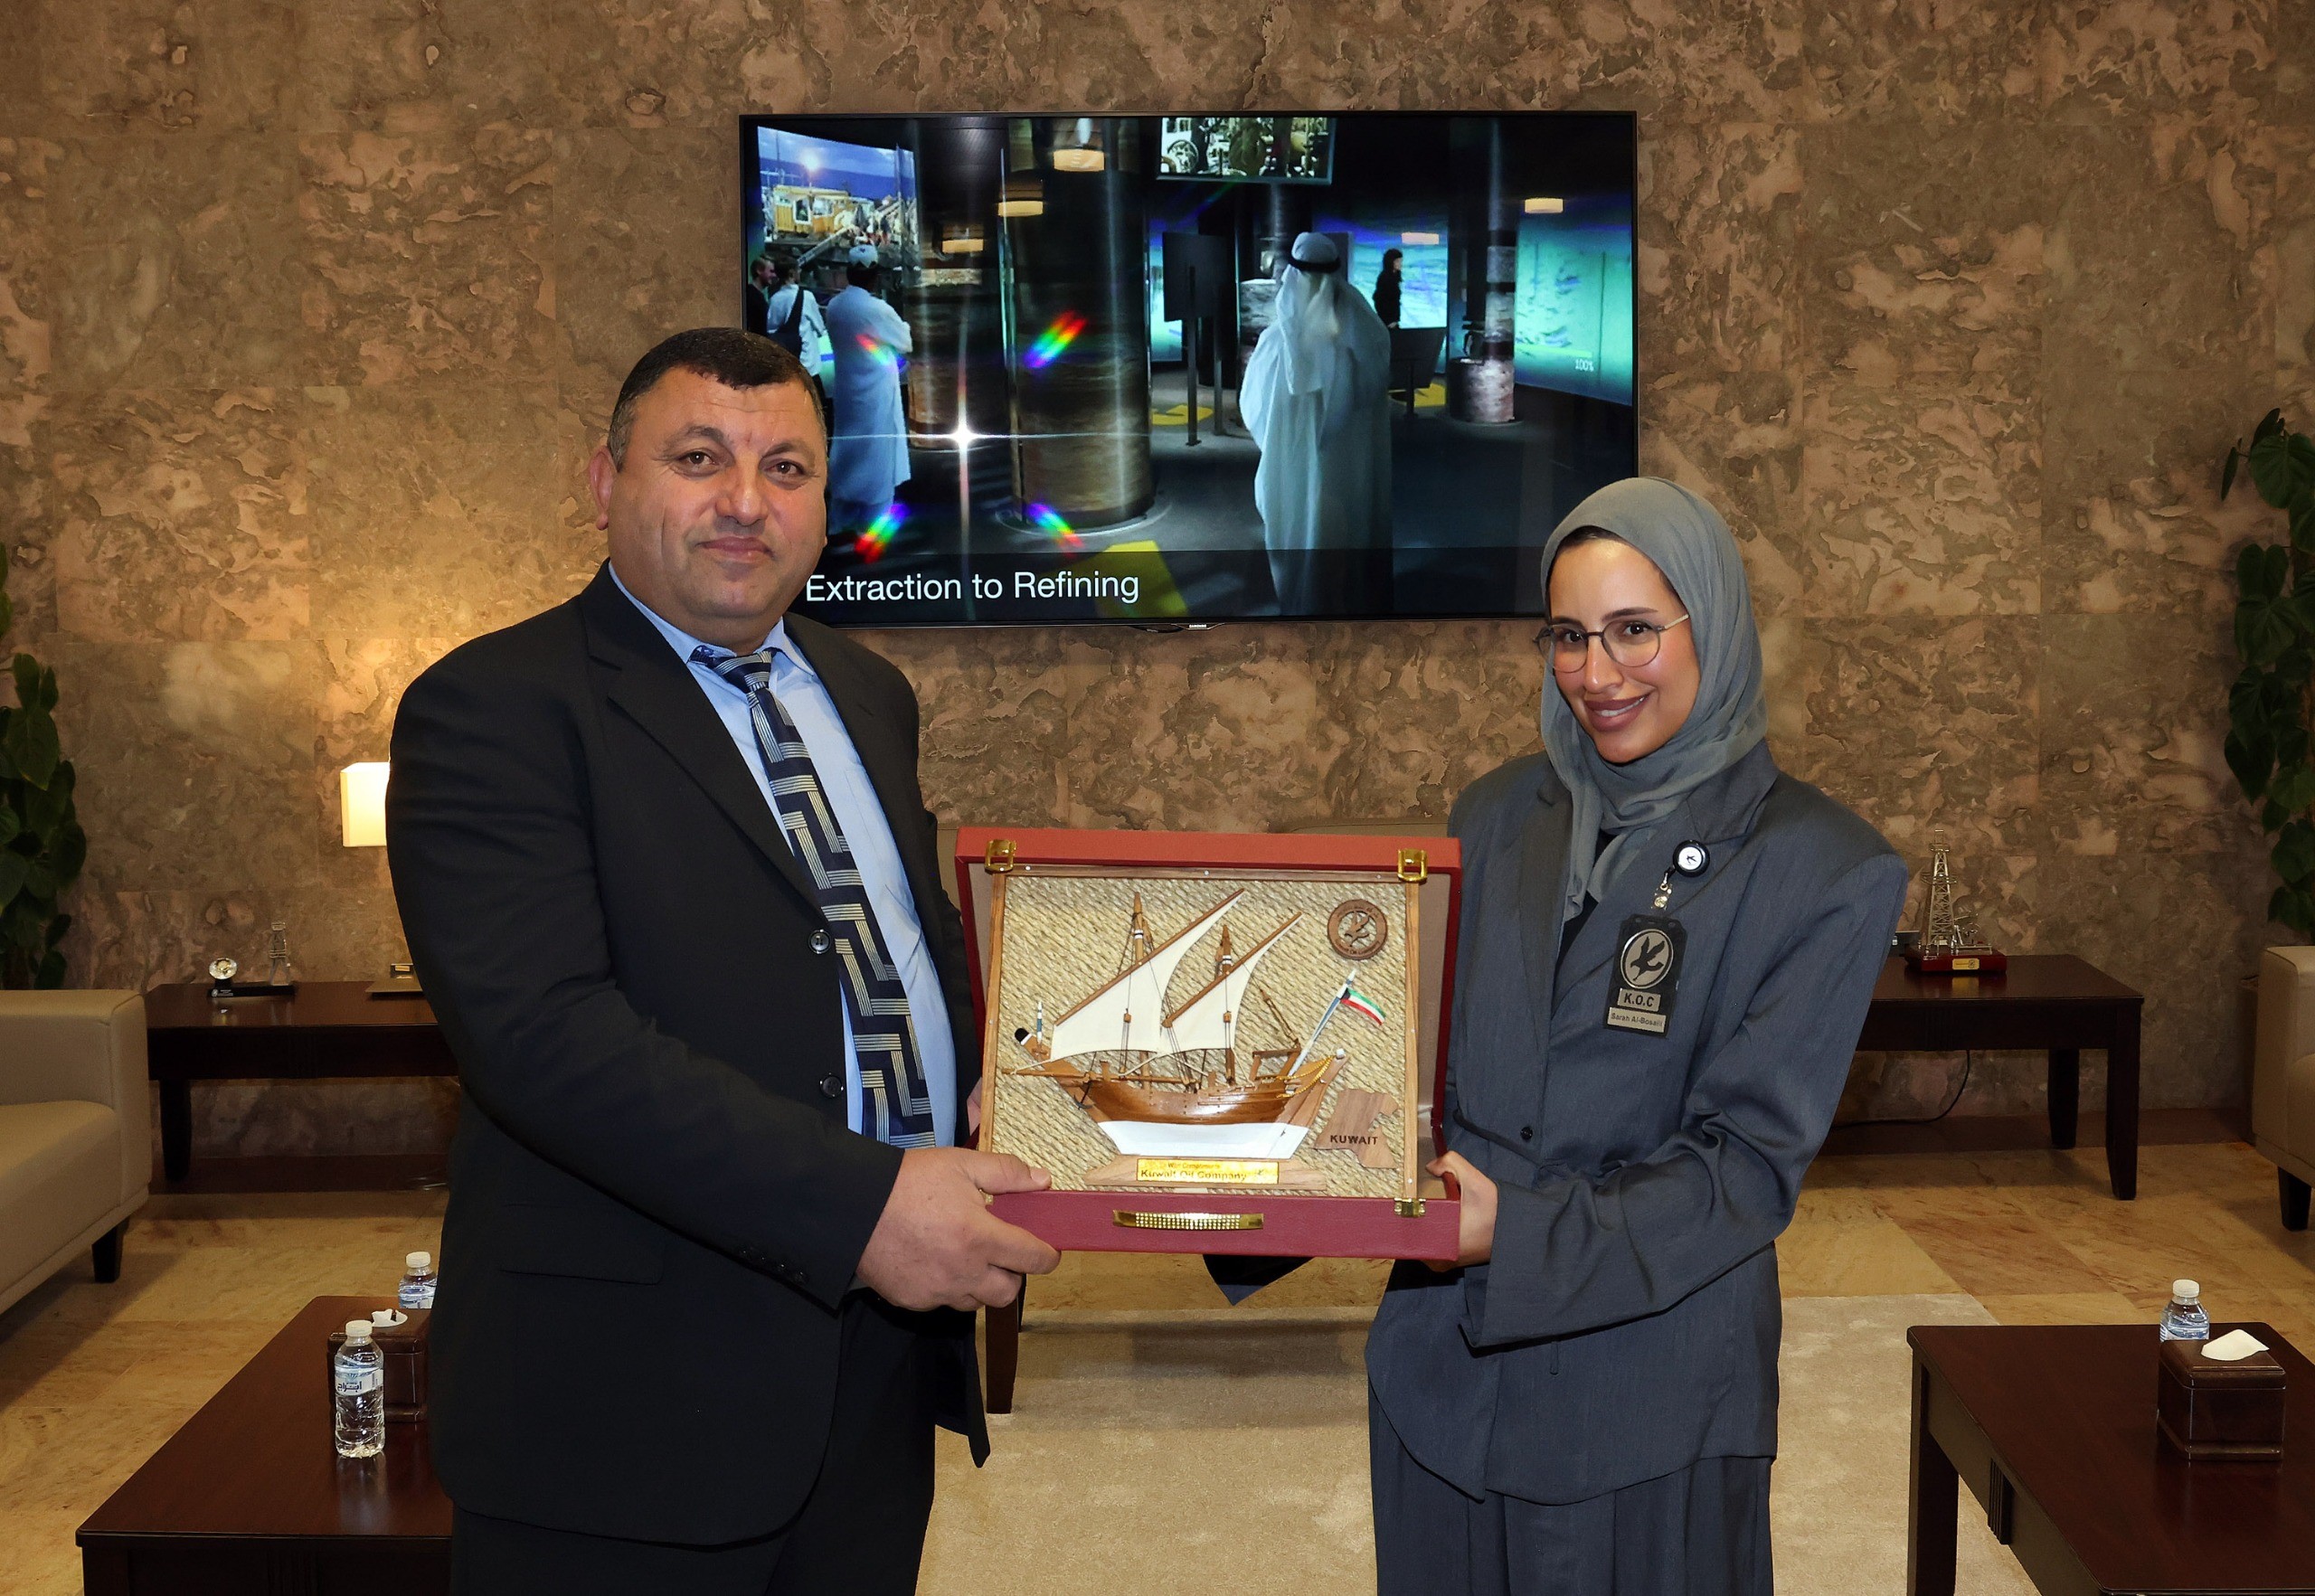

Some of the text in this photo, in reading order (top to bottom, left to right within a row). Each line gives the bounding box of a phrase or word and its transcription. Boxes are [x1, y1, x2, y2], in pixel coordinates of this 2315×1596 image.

[806, 571, 1139, 604] Extraction to Refining
[1624, 993, 1654, 1007] K.O.C
[1611, 1013, 1630, 1022] Sarah
[1330, 1135, 1378, 1146] KUWAIT
